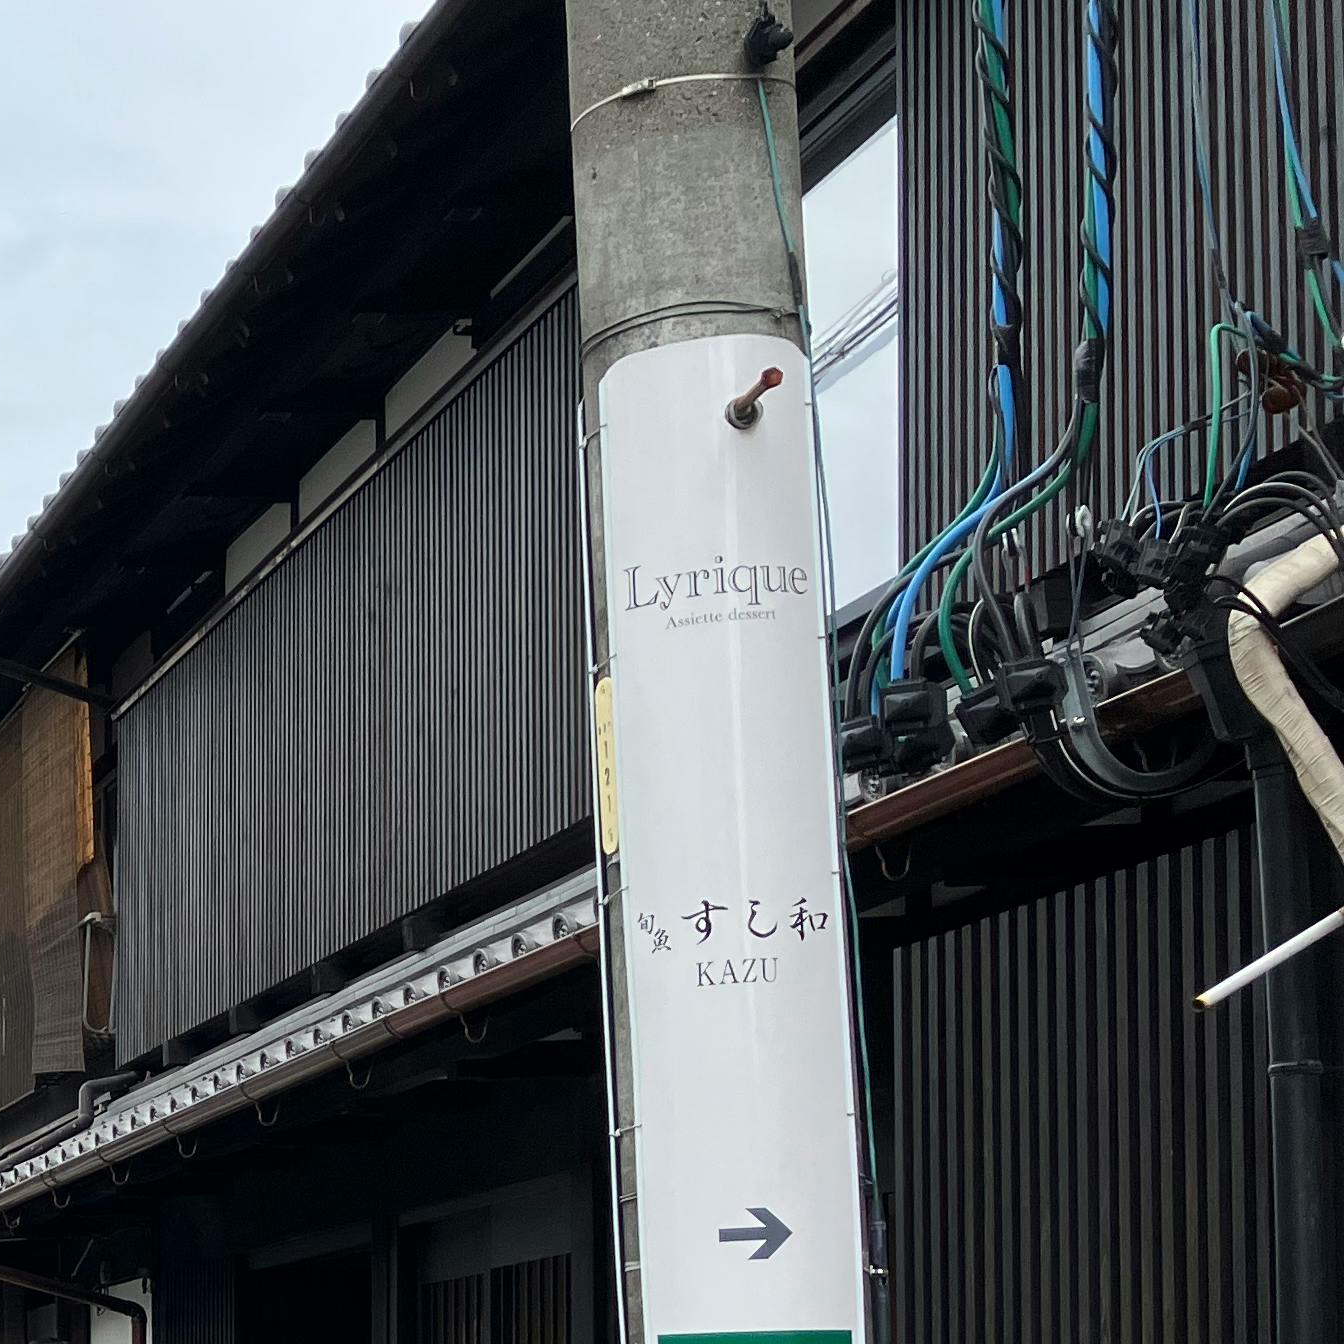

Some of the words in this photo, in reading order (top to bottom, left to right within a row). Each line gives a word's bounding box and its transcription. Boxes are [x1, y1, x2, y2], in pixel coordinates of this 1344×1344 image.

[624, 555, 808, 611] Lyrique
[665, 611, 724, 630] Assiette
[728, 607, 777, 622] dessert
[695, 957, 779, 987] KAZU
